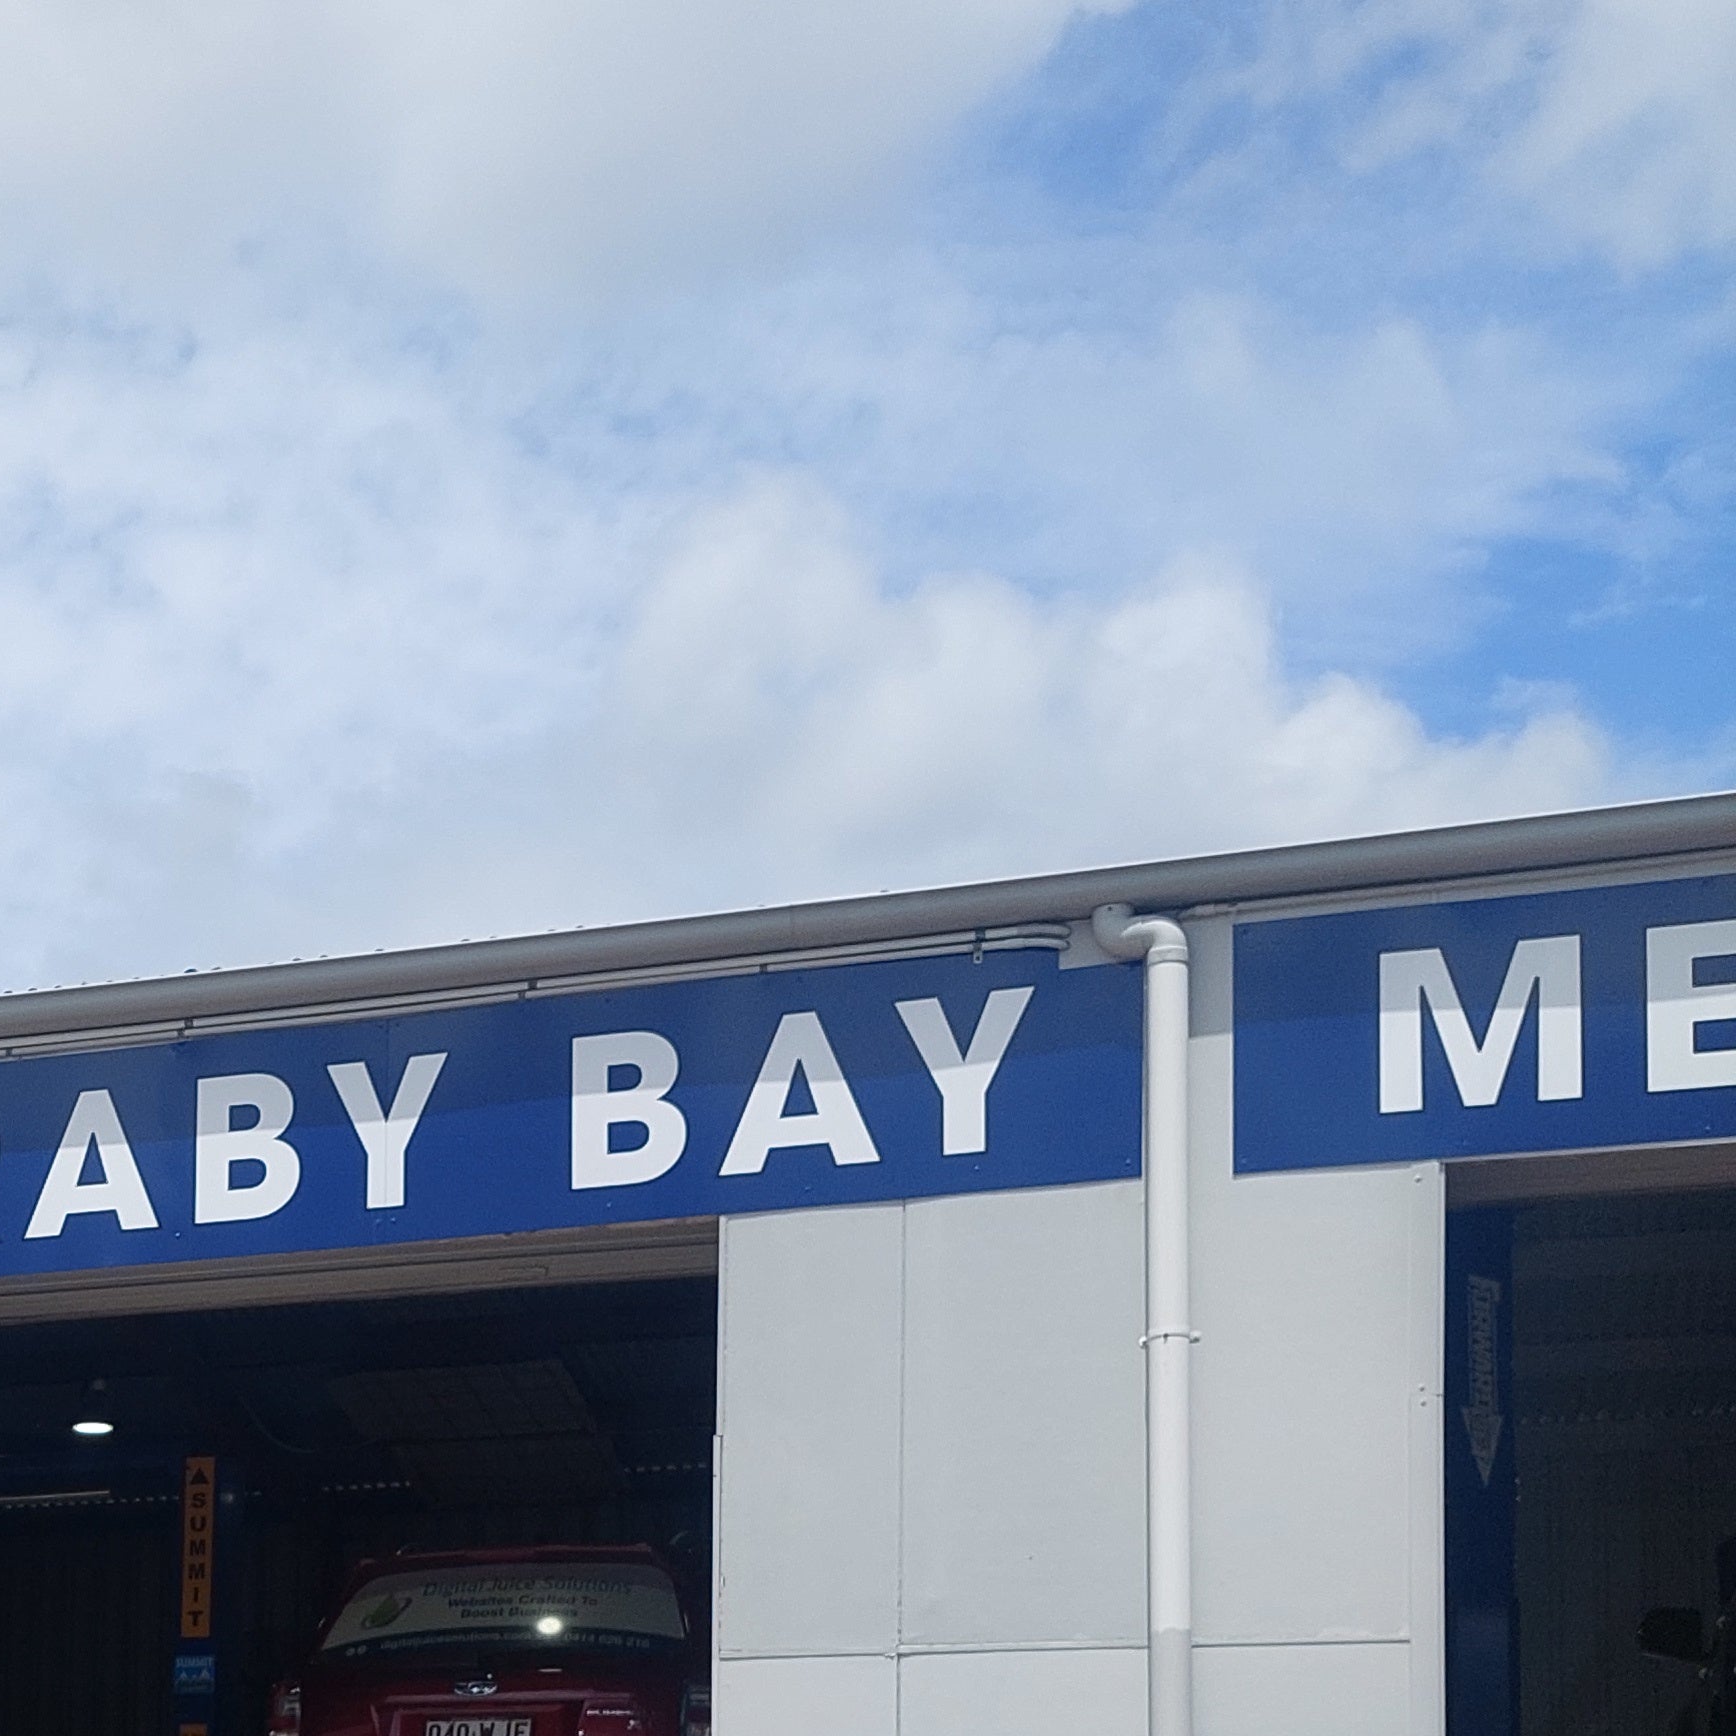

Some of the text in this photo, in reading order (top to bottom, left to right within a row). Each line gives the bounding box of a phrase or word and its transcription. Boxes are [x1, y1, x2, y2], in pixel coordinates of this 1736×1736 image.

[568, 986, 1036, 1191] BAY
[186, 1492, 208, 1627] SUMMIT
[539, 1576, 633, 1595] Solutions
